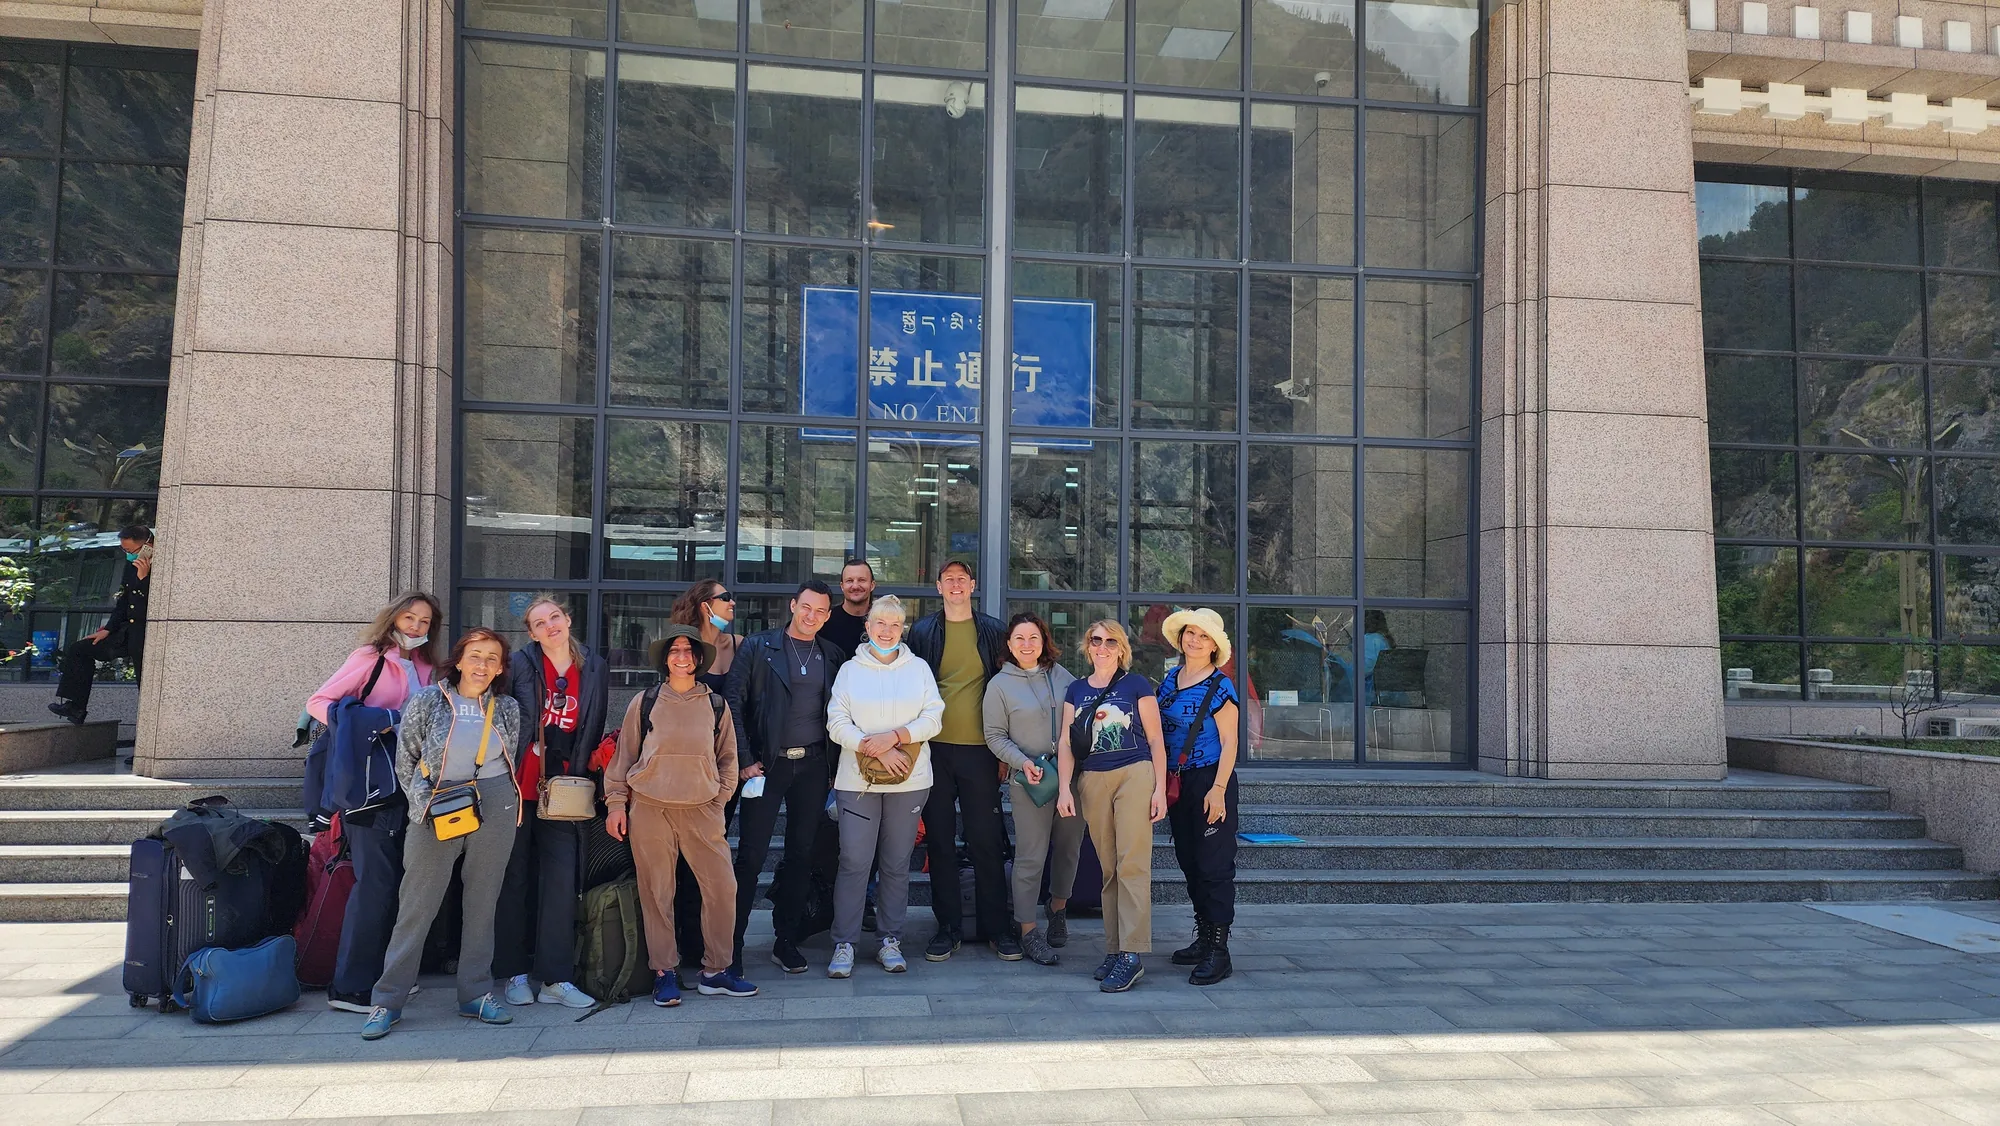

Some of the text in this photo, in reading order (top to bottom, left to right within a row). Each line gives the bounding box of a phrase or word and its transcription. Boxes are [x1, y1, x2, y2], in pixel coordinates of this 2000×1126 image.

[869, 346, 1042, 392] 禁止通行
[882, 403, 918, 421] NO
[1084, 690, 1118, 702] DASY
